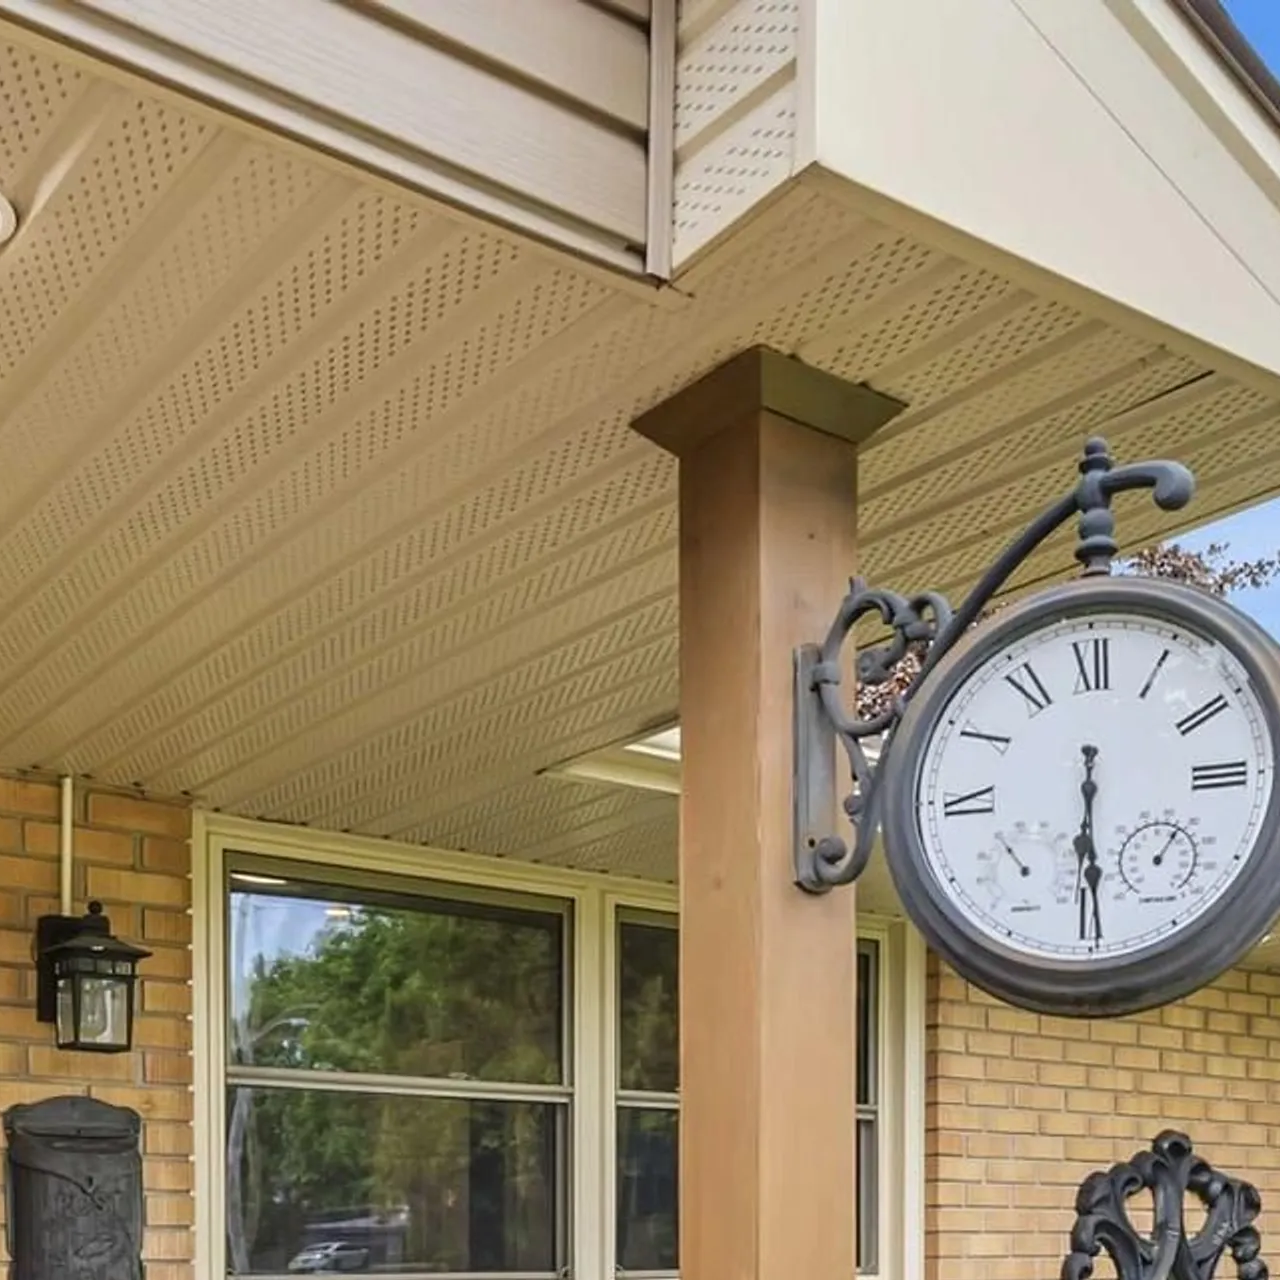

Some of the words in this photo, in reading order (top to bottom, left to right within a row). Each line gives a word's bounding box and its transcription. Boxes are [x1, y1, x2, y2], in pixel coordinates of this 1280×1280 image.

[1072, 638, 1111, 694] XII
[1004, 662, 1053, 718] XI
[1176, 693, 1229, 736] II
[1191, 761, 1247, 790] III
[943, 786, 995, 816] IX
